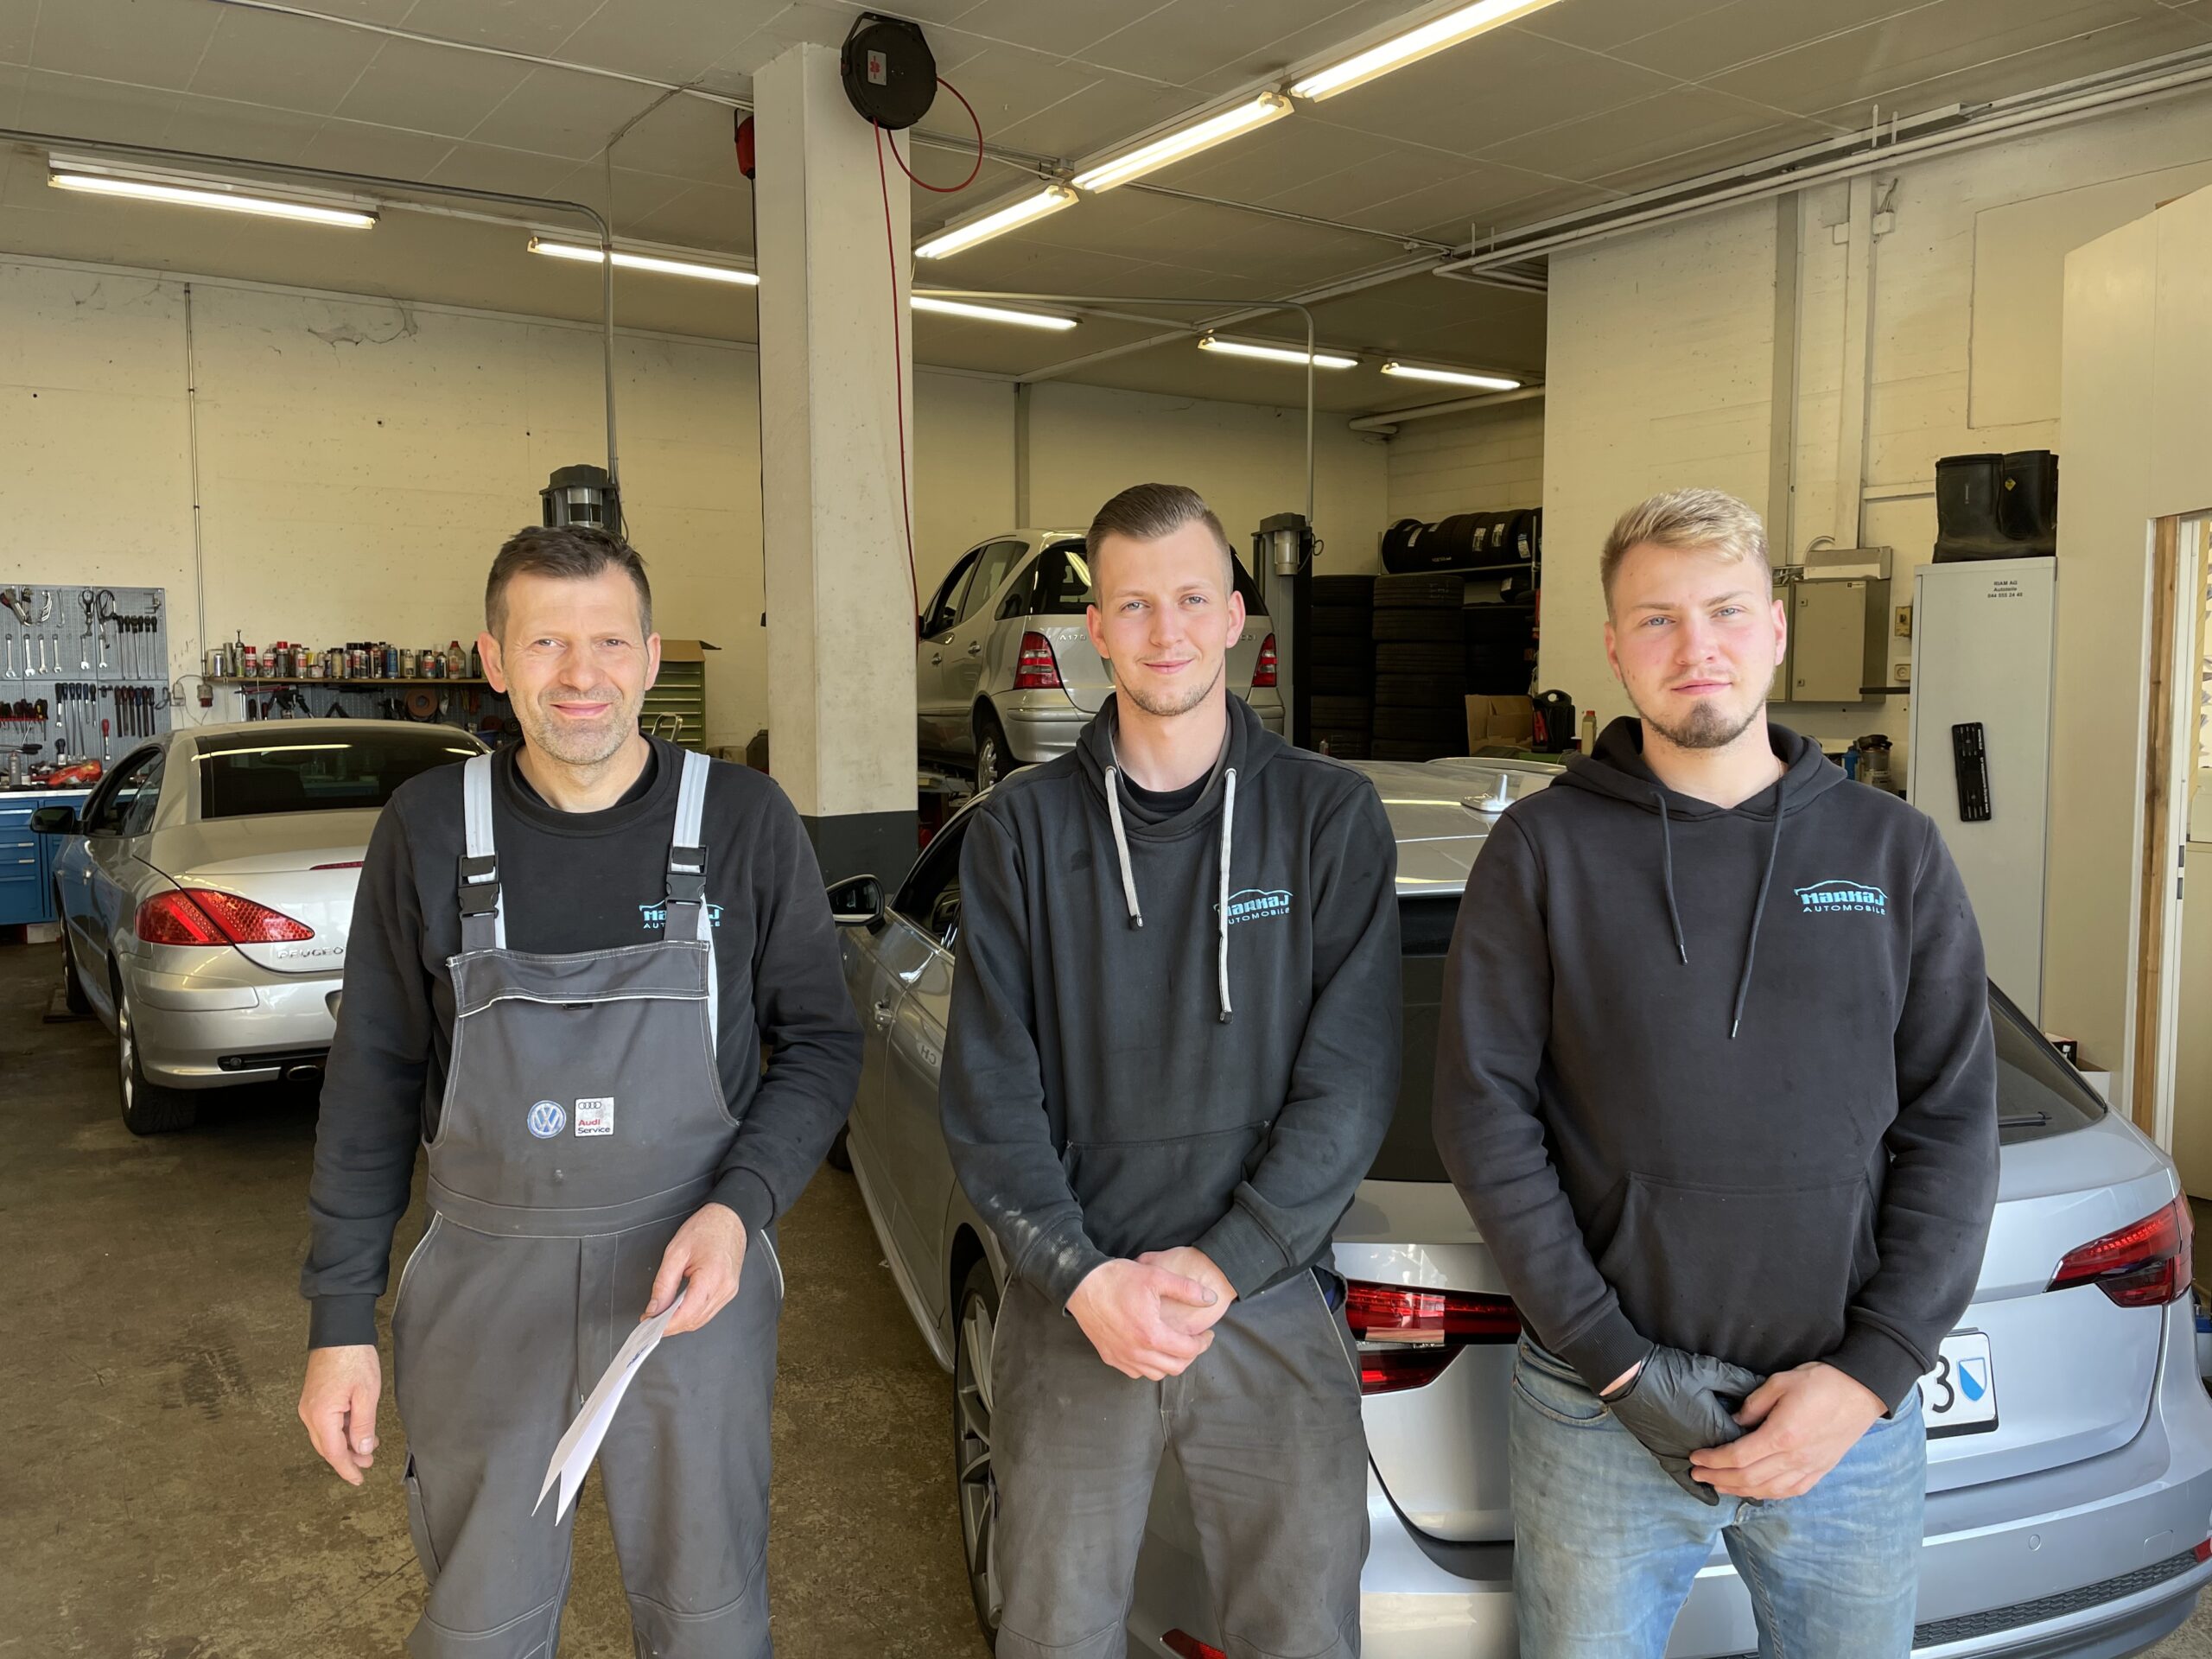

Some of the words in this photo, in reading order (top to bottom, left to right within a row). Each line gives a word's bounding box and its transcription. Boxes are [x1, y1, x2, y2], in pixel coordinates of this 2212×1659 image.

[1227, 907, 1290, 925] UTOMOBILE
[1802, 904, 1886, 916] AUTOMOBILE
[277, 946, 345, 959] PEUGEO
